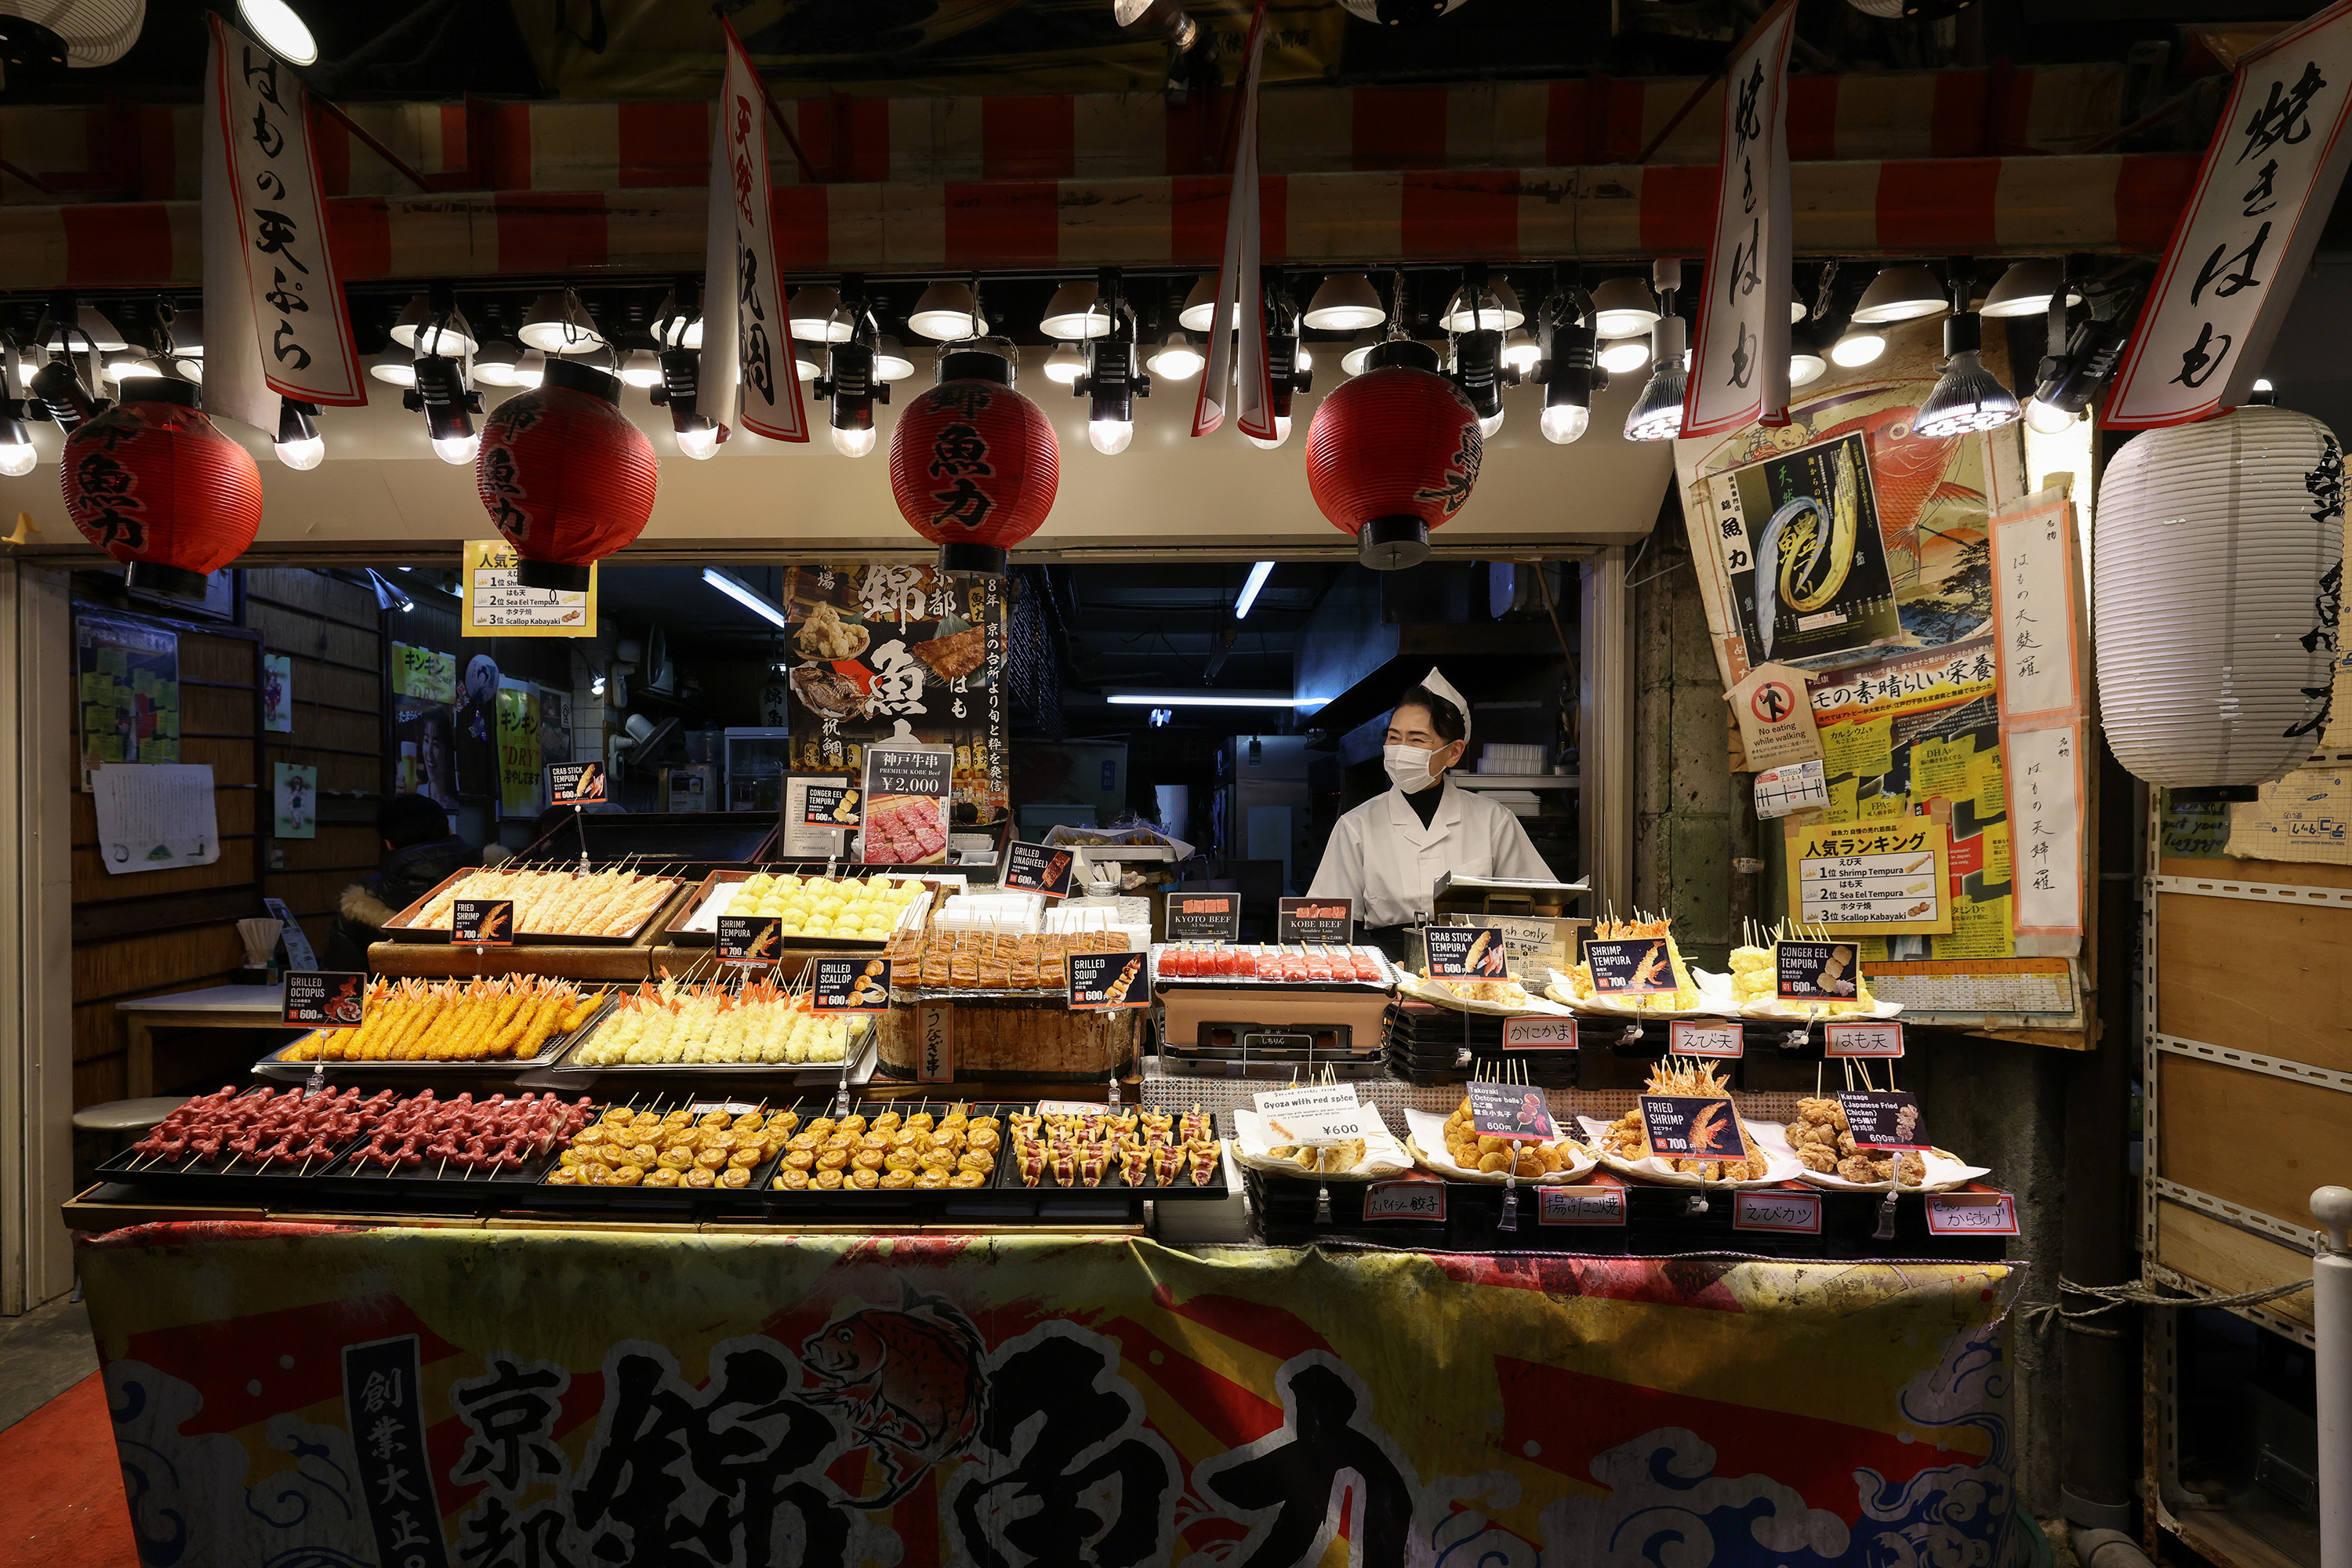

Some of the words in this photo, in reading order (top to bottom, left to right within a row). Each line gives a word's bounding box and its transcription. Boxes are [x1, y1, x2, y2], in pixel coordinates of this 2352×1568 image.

[242, 45, 309, 371] はもの天ぷら
[1727, 58, 1764, 390] 焼きはも
[2169, 61, 2327, 388] 焼きはも
[405, 651, 445, 675] キンキン
[949, 675, 968, 719] はも
[1772, 723, 1796, 733] eating
[822, 718, 843, 758] 祝鯛
[1754, 737, 1773, 746] while
[1775, 731, 1806, 742] walking
[883, 753, 938, 768] 神戸牛串
[554, 775, 579, 783] TEMPURA
[809, 797, 835, 806] TEMPURA
[1850, 825, 1897, 835] 自慢の売れ筋商品
[1805, 831, 1926, 858] 人気ランキング
[1014, 847, 1040, 858] GRILLED
[1013, 855, 1048, 869] UNAGI(EEL)
[1838, 858, 1862, 866] えび天
[1838, 869, 1867, 878] Shrimp
[1868, 867, 1904, 877] Tempura
[1839, 880, 1863, 888] はも天
[1868, 891, 1904, 899] Tempura
[457, 903, 474, 912] FRIED
[456, 912, 480, 921] SHRIMP
[1841, 913, 1869, 923] Scallop
[1870, 912, 1907, 922] Kabayaki
[720, 920, 746, 928] SHRIMP
[720, 928, 750, 938] TEMPURA
[1430, 932, 1450, 942] CRAB
[1452, 933, 1473, 943] STICK
[1523, 927, 1548, 943] only
[1431, 942, 1468, 953] TEMPURA
[1591, 945, 1621, 957] SHRIMP
[1781, 946, 1813, 958] CONGER
[1814, 947, 1828, 959] EEL
[1075, 959, 1105, 970] GRILLED
[1592, 955, 1632, 967] TEMPURA
[1781, 957, 1818, 969] TEMPURA
[821, 964, 851, 974] GRILLED
[1075, 969, 1098, 980] SQUID
[291, 977, 322, 987] GRILLED
[820, 974, 852, 984] SCALLOP
[291, 987, 325, 998] OCTOPUS
[1510, 1024, 1569, 1041] かにかま
[1682, 1030, 1733, 1049] えび天
[1835, 1031, 1888, 1050] はも天
[1469, 1087, 1499, 1095] Takoyaki
[1264, 1101, 1290, 1110] Gyoza
[1331, 1094, 1353, 1104] spice
[1840, 1093, 1869, 1102] Karaage
[1647, 1102, 1673, 1113] FRIED
[1650, 1113, 1684, 1126] SHRIMP
[1323, 1123, 1359, 1135] ¥600
[1486, 1122, 1512, 1131] 600円
[1869, 1134, 1896, 1143] 600円
[1370, 1196, 1438, 1215] スパイシー餃子
[1545, 1194, 1621, 1217] 揚げたこ焼
[1747, 1203, 1812, 1225] えびカツ
[1947, 1207, 2005, 1226] からあげ
